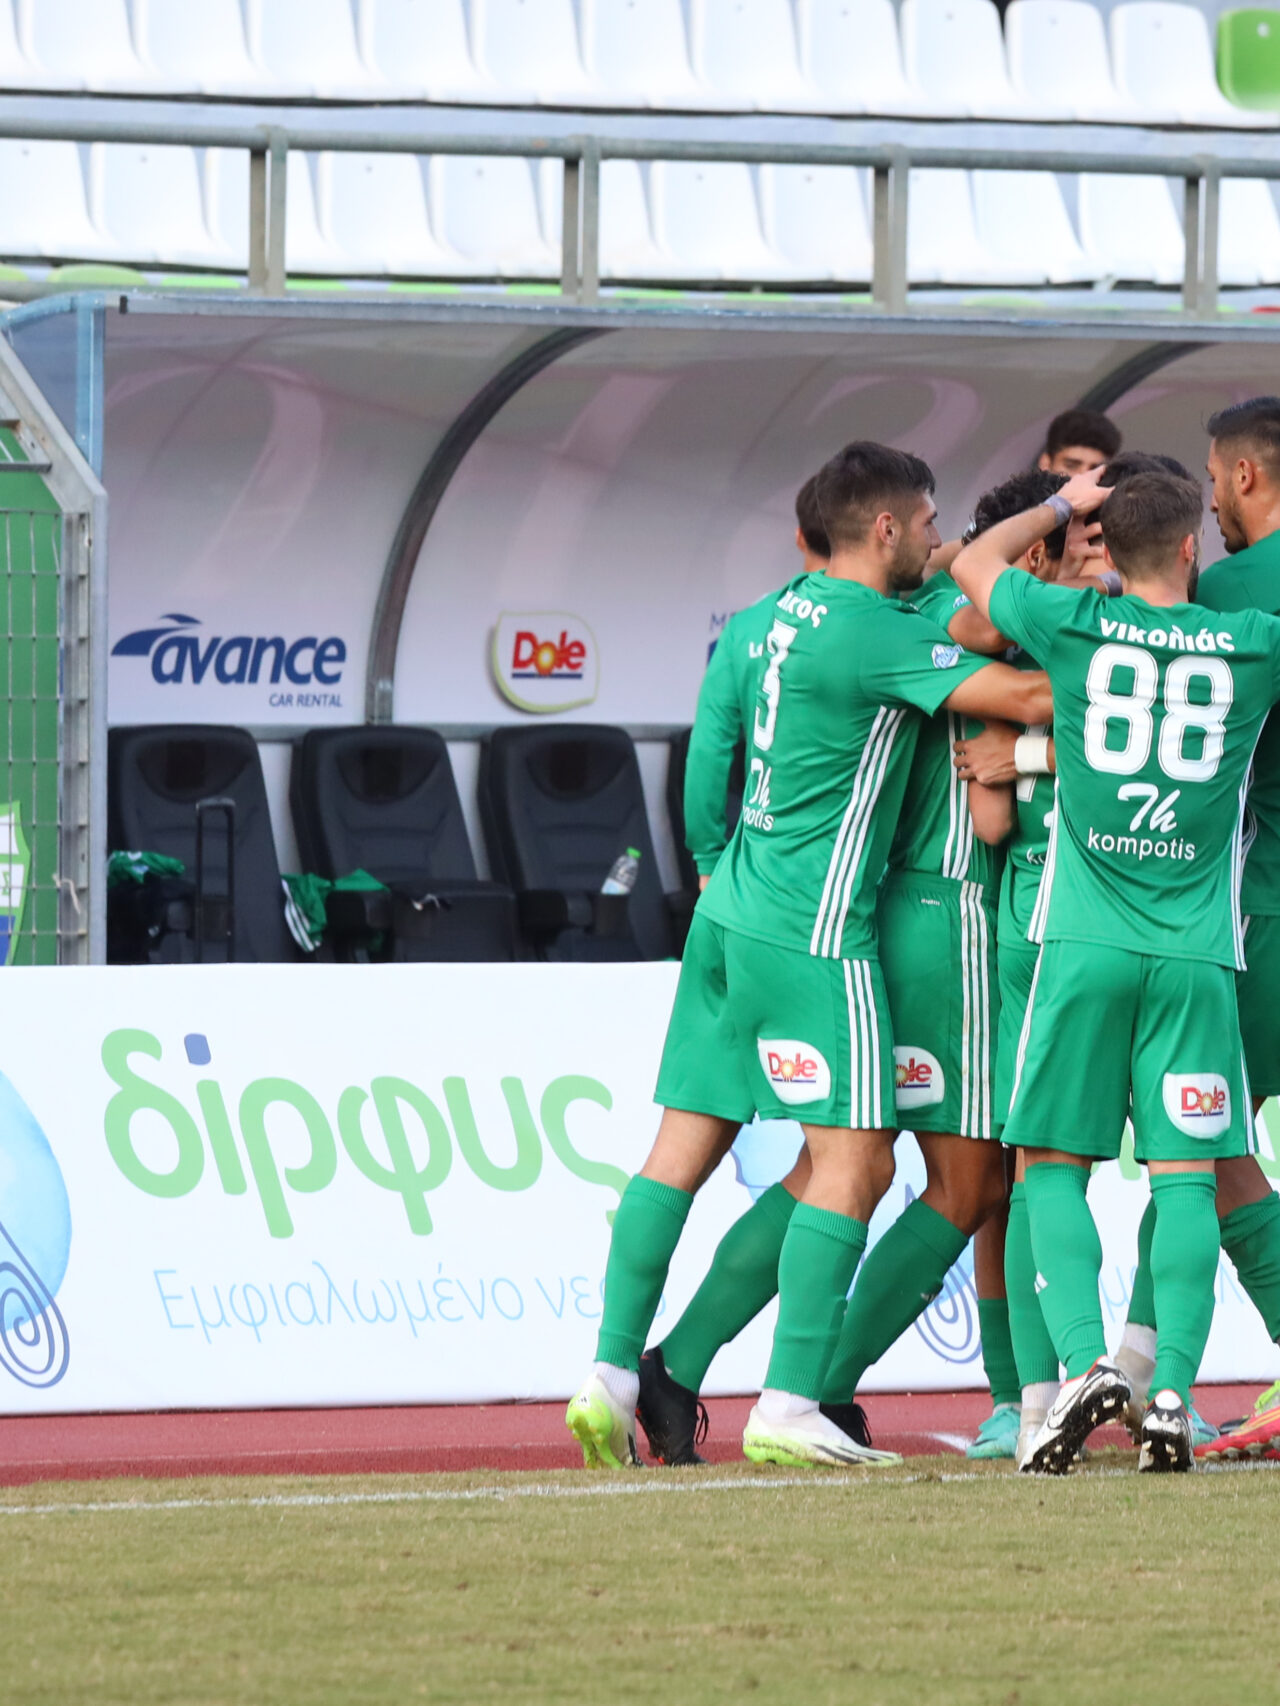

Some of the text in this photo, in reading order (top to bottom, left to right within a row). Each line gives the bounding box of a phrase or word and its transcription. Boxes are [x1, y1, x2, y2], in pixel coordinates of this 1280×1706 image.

[151, 635, 347, 686] avance
[512, 629, 587, 677] Dole
[269, 693, 344, 708] CAR RENTAL
[1083, 642, 1234, 783] 88
[1087, 826, 1196, 862] kompotis
[768, 1052, 818, 1083] Dole
[896, 1057, 932, 1085] ole
[1181, 1085, 1226, 1113] Dole
[153, 1260, 524, 1345] Εμφιαλωμένο
